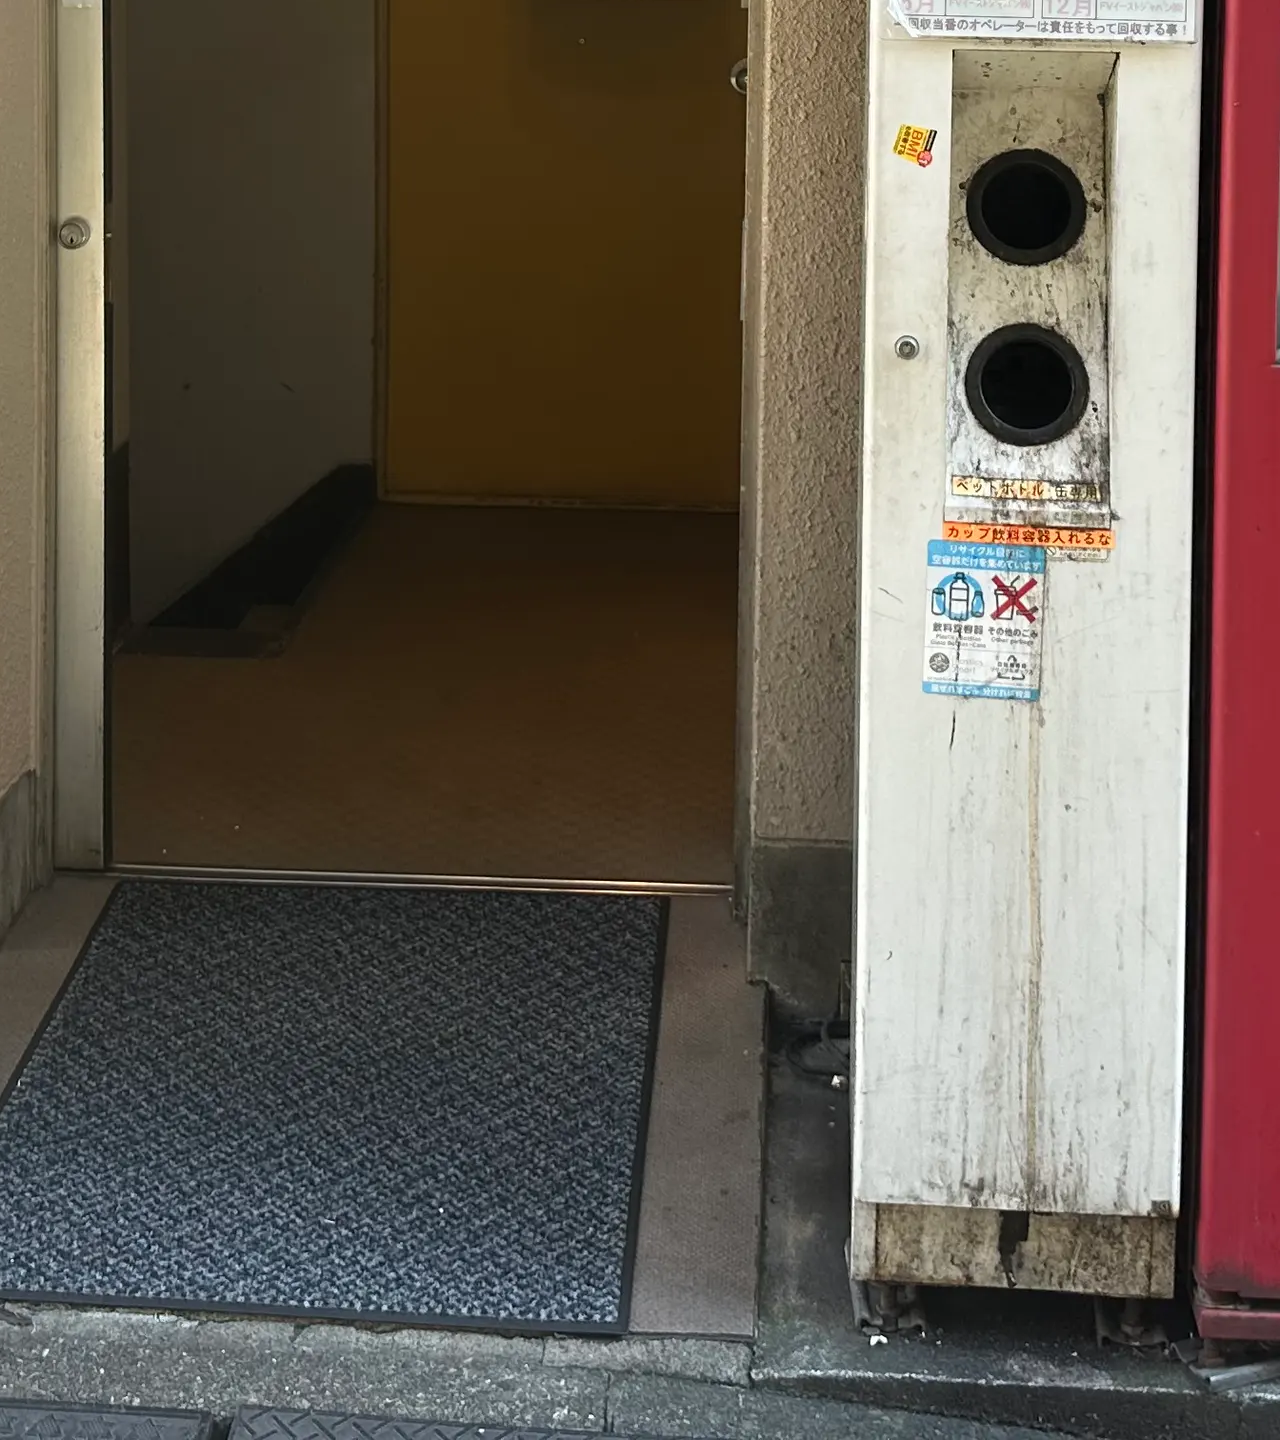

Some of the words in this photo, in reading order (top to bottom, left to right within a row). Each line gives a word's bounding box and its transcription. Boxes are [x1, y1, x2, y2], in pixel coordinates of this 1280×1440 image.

[957, 481, 1044, 496] ペットボトル
[947, 525, 1112, 545] カップ飲料容器入れるな
